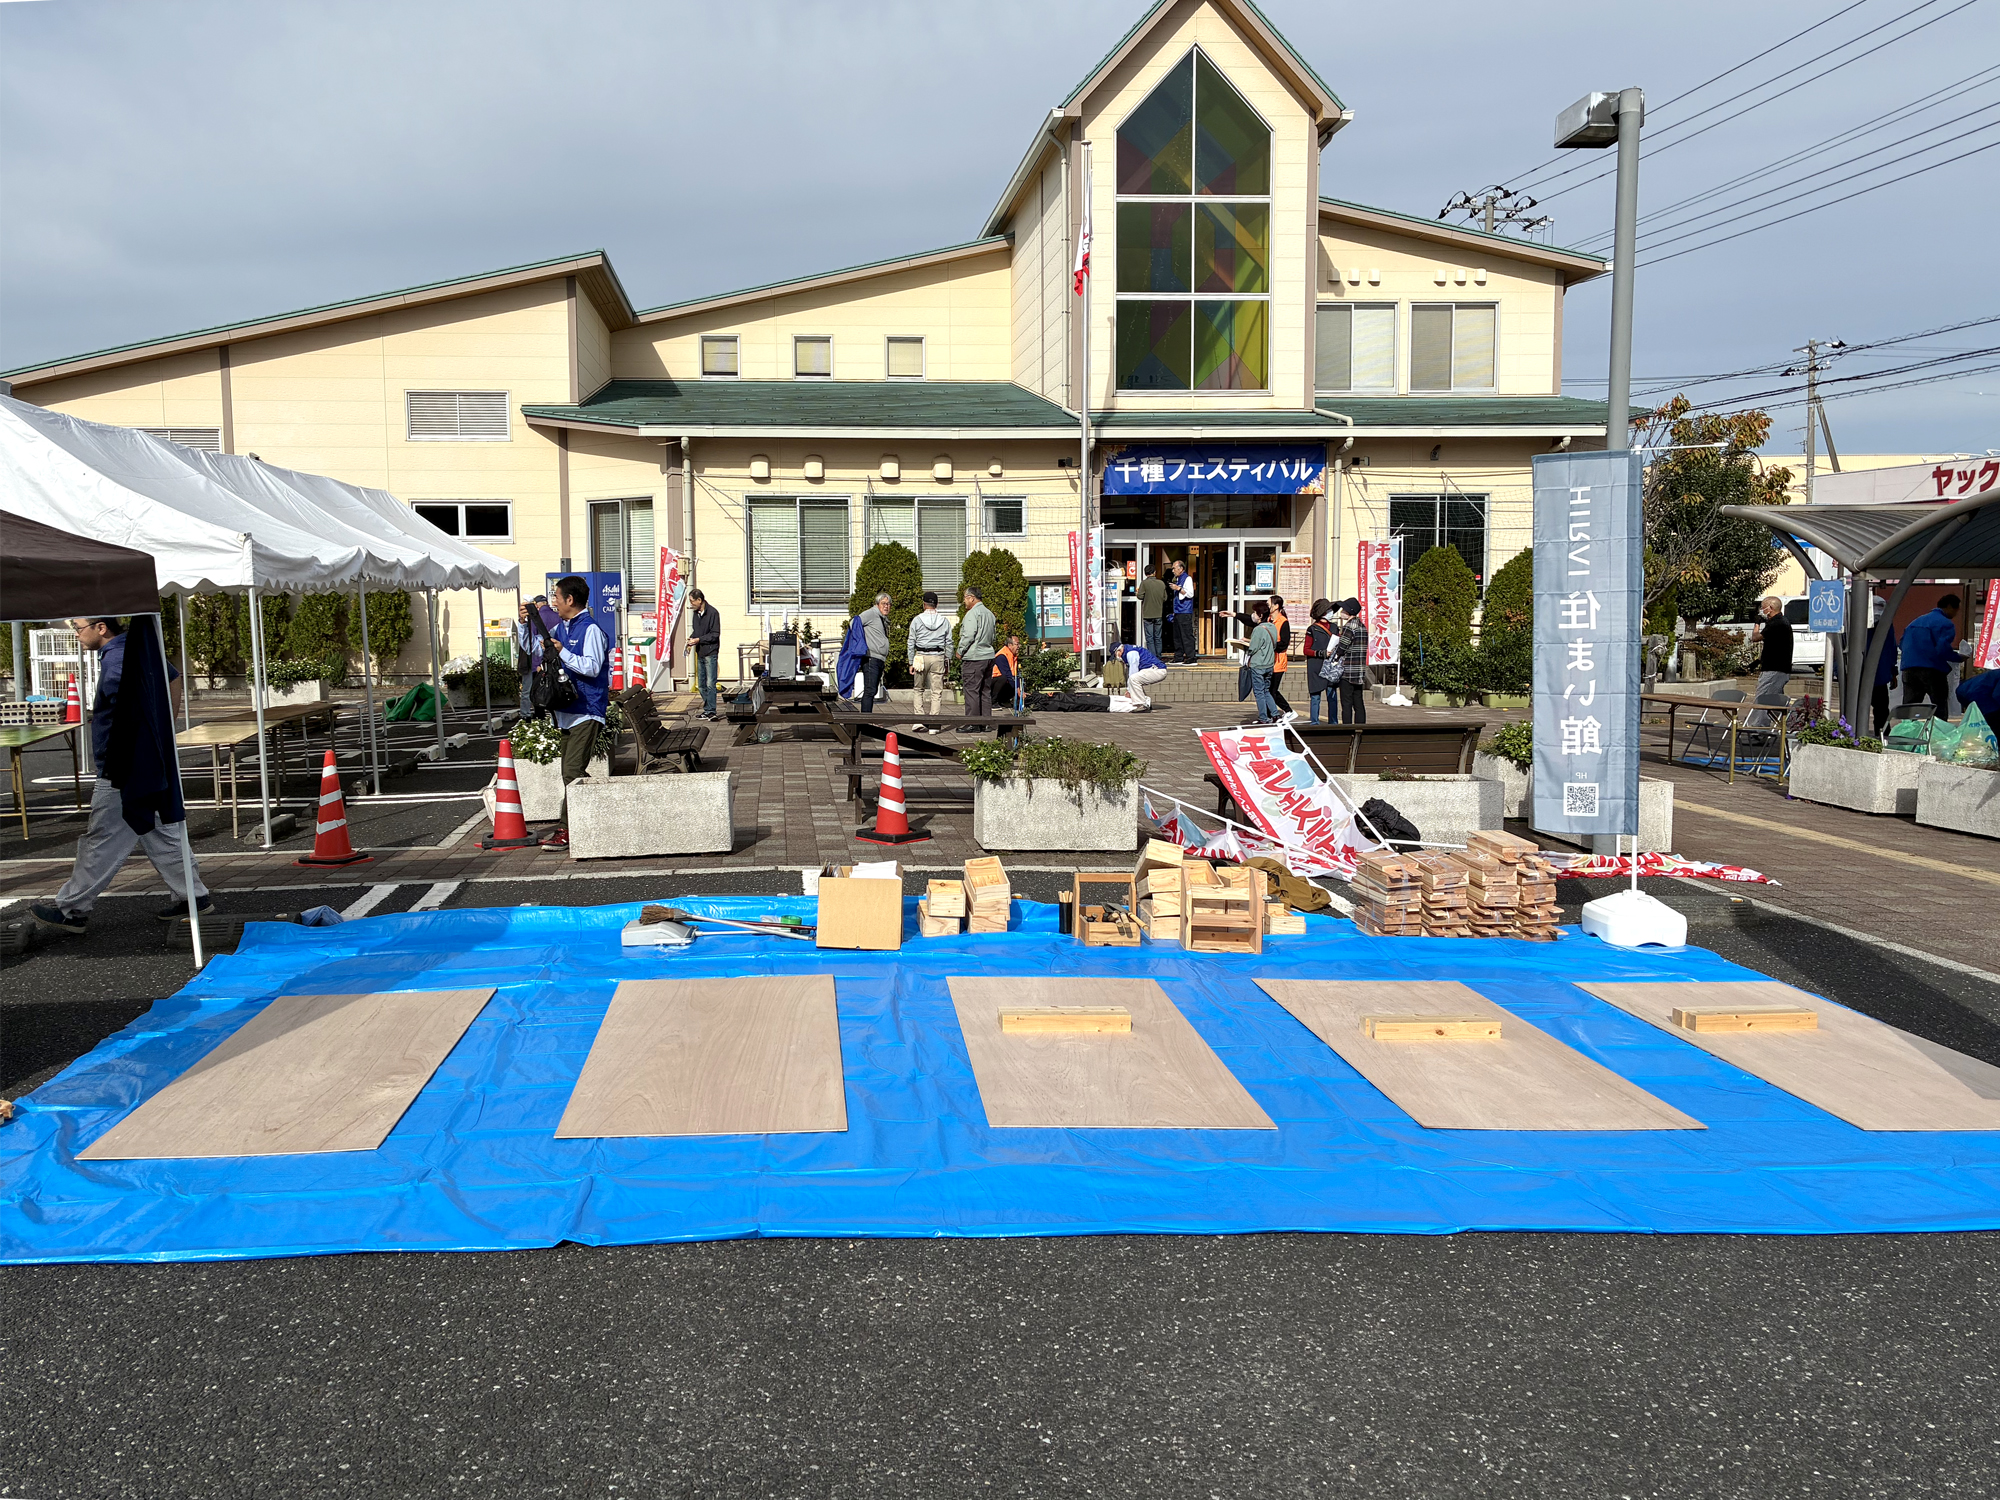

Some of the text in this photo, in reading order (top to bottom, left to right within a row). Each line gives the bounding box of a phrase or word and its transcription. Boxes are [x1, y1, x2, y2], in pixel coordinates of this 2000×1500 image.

[1114, 456, 1314, 484] 千種フェスティバル
